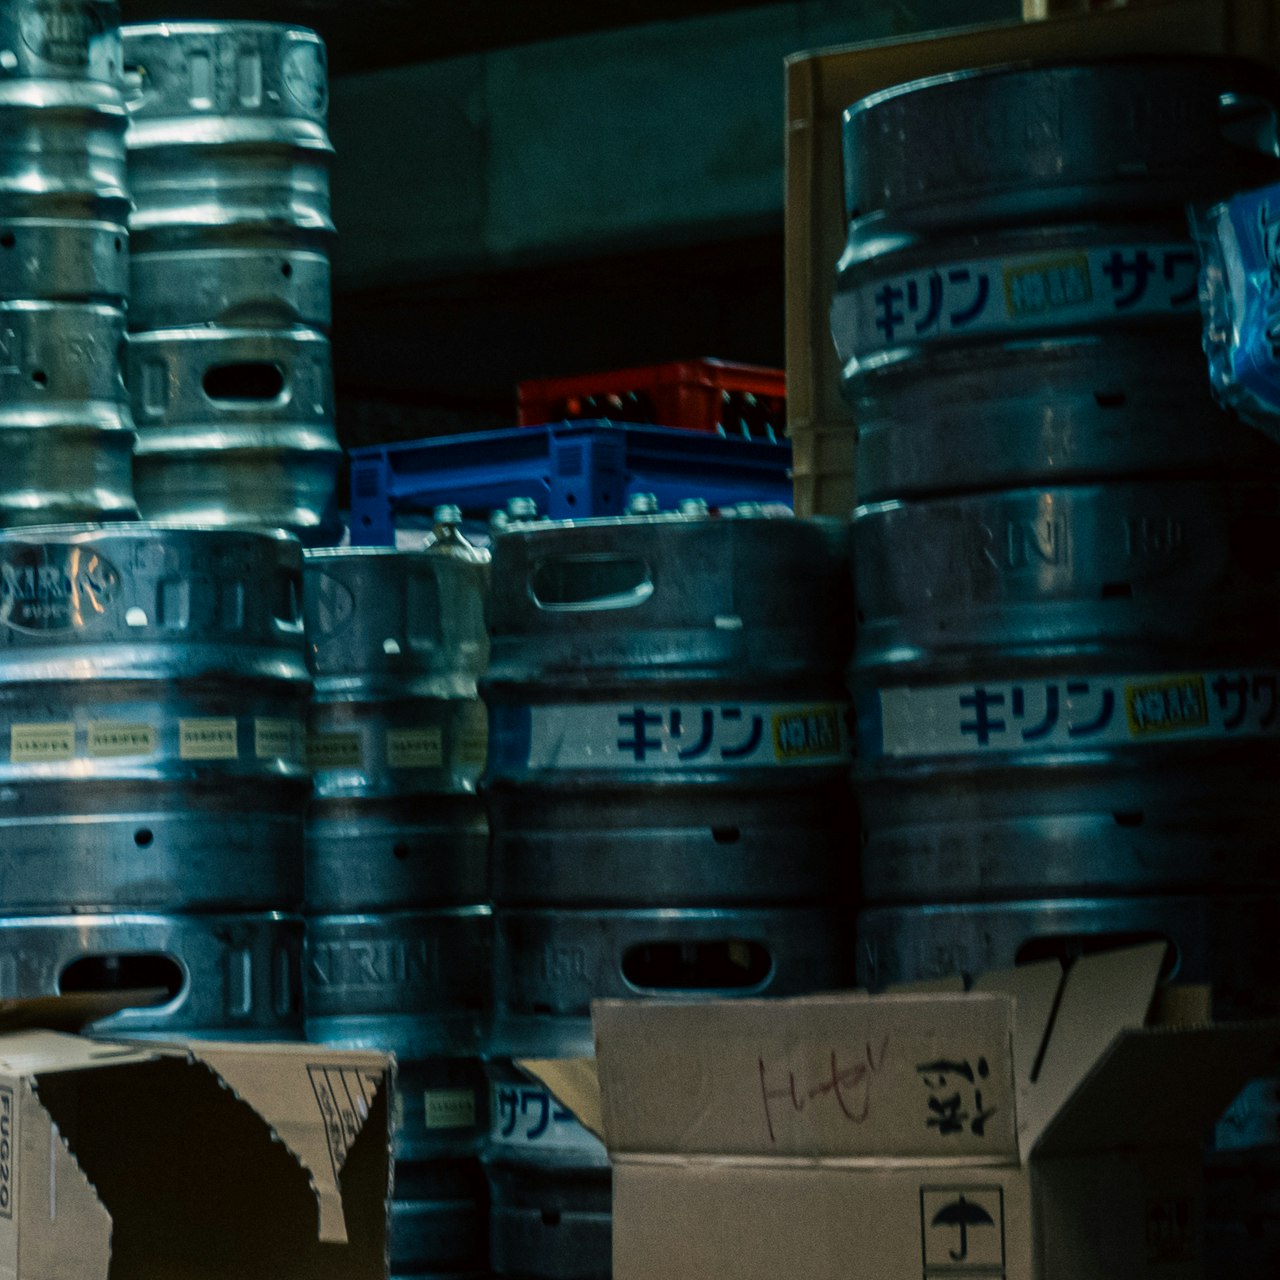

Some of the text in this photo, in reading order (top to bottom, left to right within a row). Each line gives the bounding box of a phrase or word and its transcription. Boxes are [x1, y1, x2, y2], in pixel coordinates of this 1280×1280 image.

[876, 267, 989, 339] キリン
[617, 706, 763, 764] キリン
[959, 685, 1115, 747] キリン
